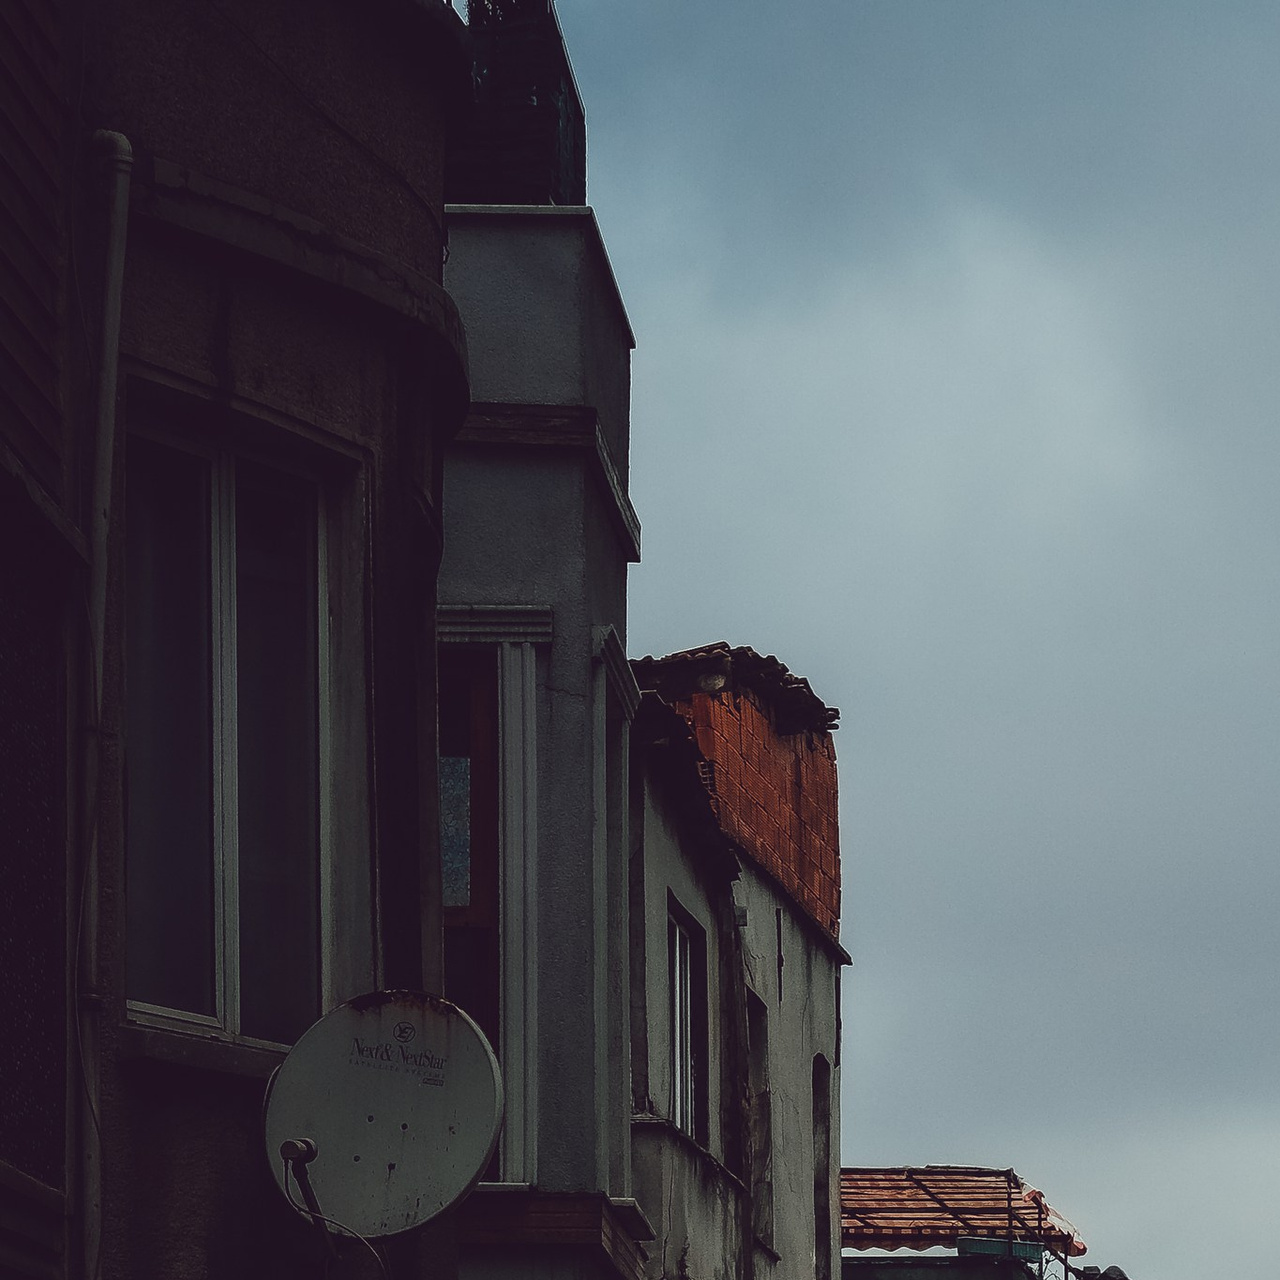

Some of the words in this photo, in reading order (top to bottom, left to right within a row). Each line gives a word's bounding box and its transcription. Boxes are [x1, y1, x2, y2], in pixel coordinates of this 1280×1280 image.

[350, 1038, 381, 1059] Next
[379, 1043, 392, 1062] &
[396, 1045, 447, 1070] NextStar
